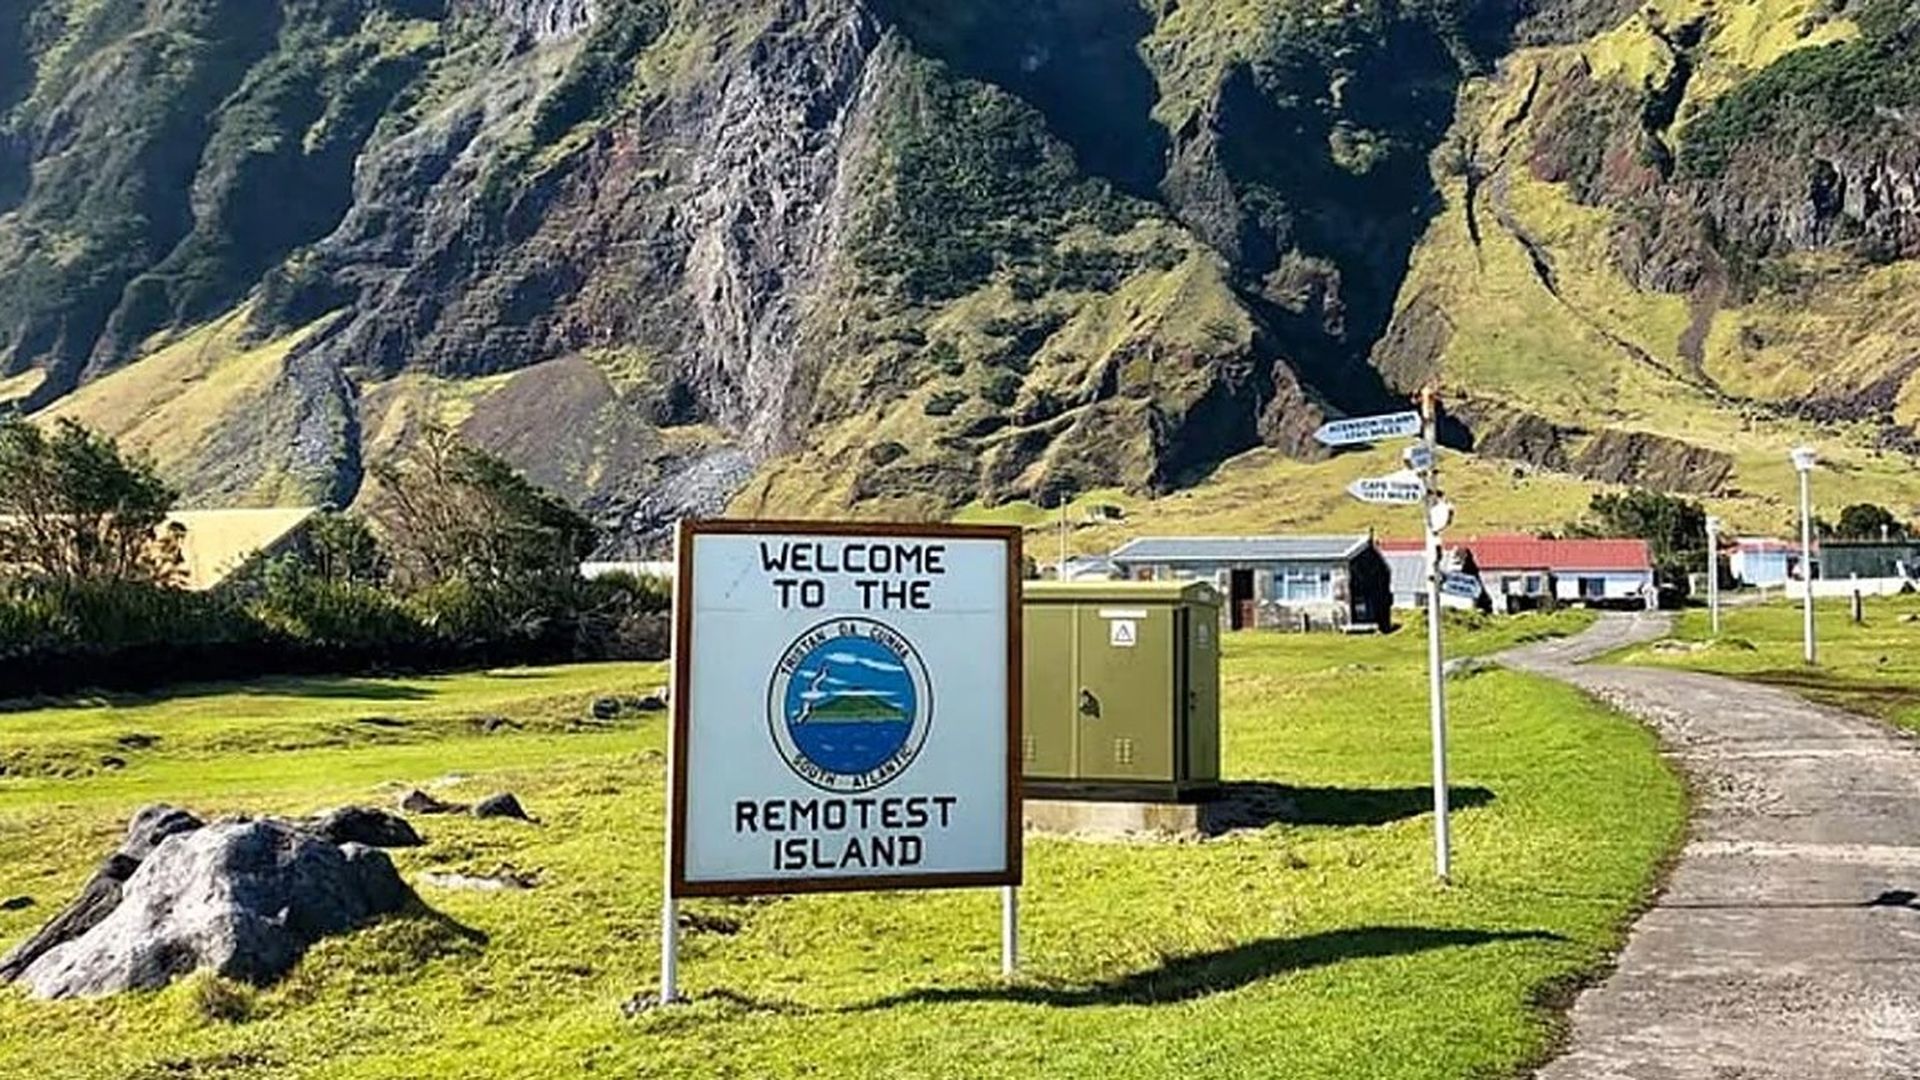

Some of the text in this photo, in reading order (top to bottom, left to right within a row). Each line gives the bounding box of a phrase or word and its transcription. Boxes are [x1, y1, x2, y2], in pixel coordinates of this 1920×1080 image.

[1361, 481, 1420, 491] CAPE TOWN
[760, 542, 946, 574] WELCOME
[773, 579, 931, 609] TO THE
[780, 622, 910, 675] TRISTAN DA CUNHA
[792, 744, 912, 787] SOUTH ATLANTIC
[736, 796, 957, 833] REMOTEST
[774, 836, 922, 870] ISLAND
